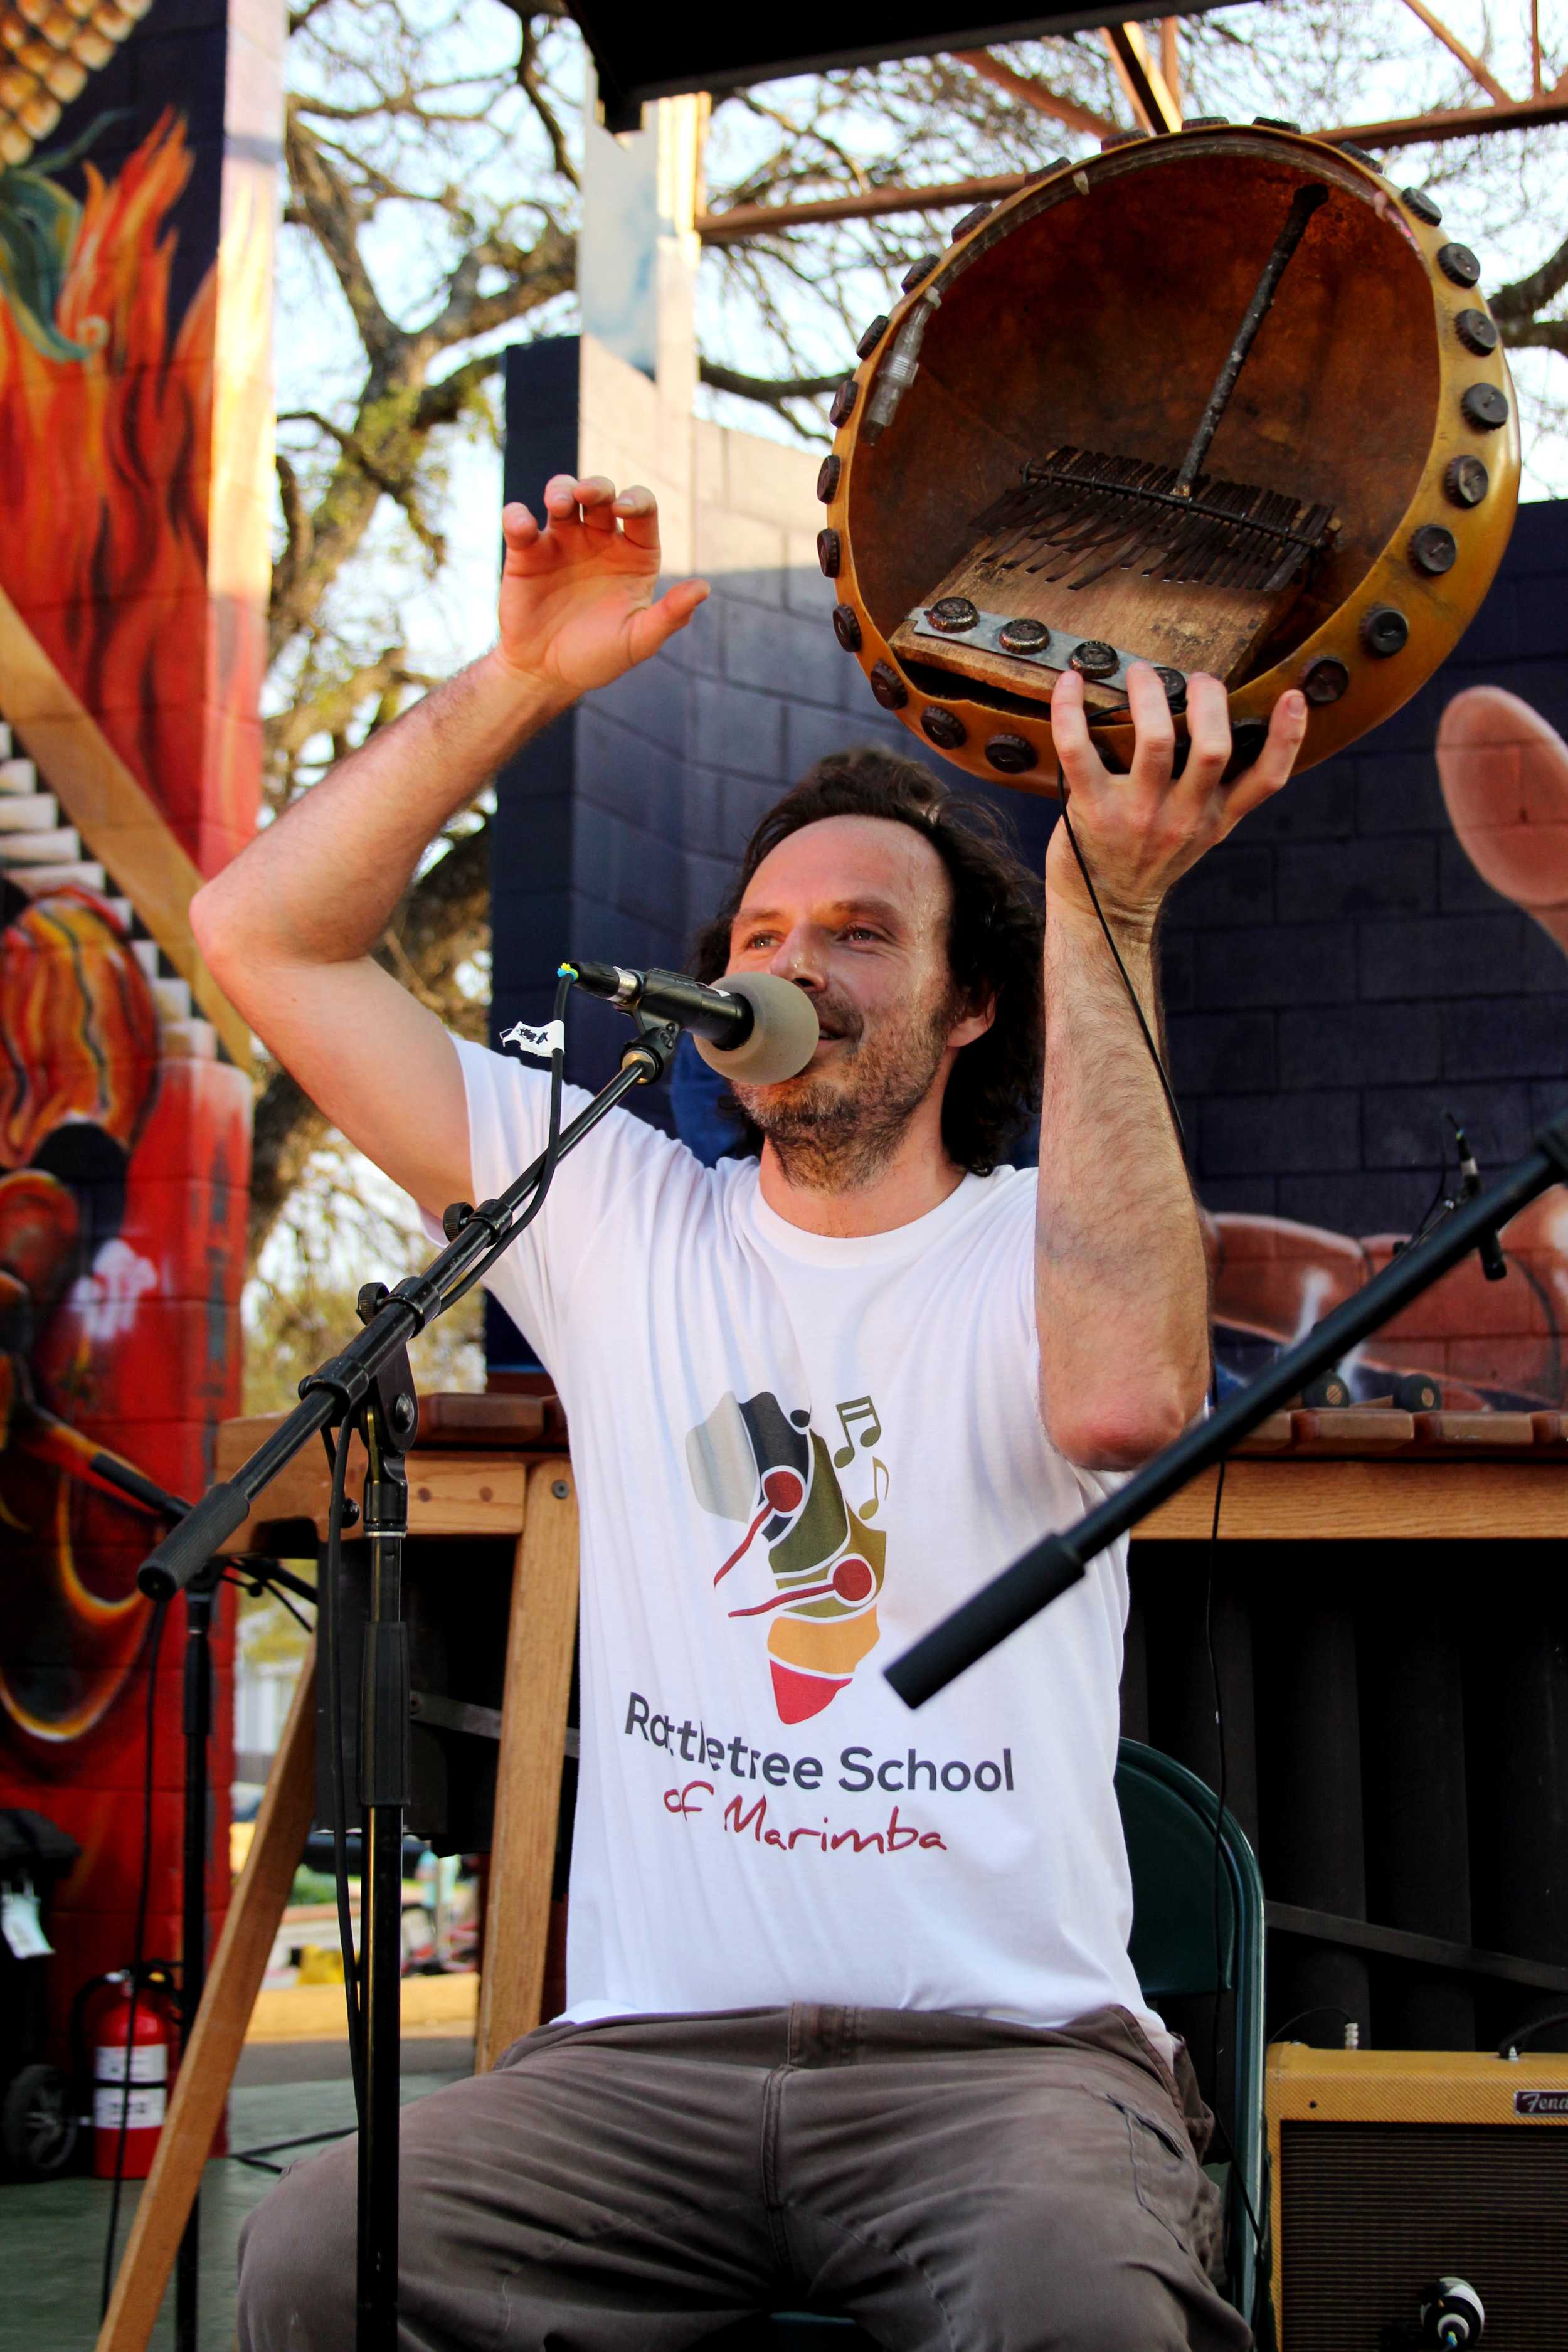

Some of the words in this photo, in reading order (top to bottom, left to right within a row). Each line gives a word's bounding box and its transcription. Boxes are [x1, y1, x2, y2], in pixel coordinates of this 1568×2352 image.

[625, 1692, 823, 1790] Rattletree
[838, 1747, 1014, 1792] School
[664, 1780, 714, 1821] of
[724, 1794, 947, 1854] Marimba
